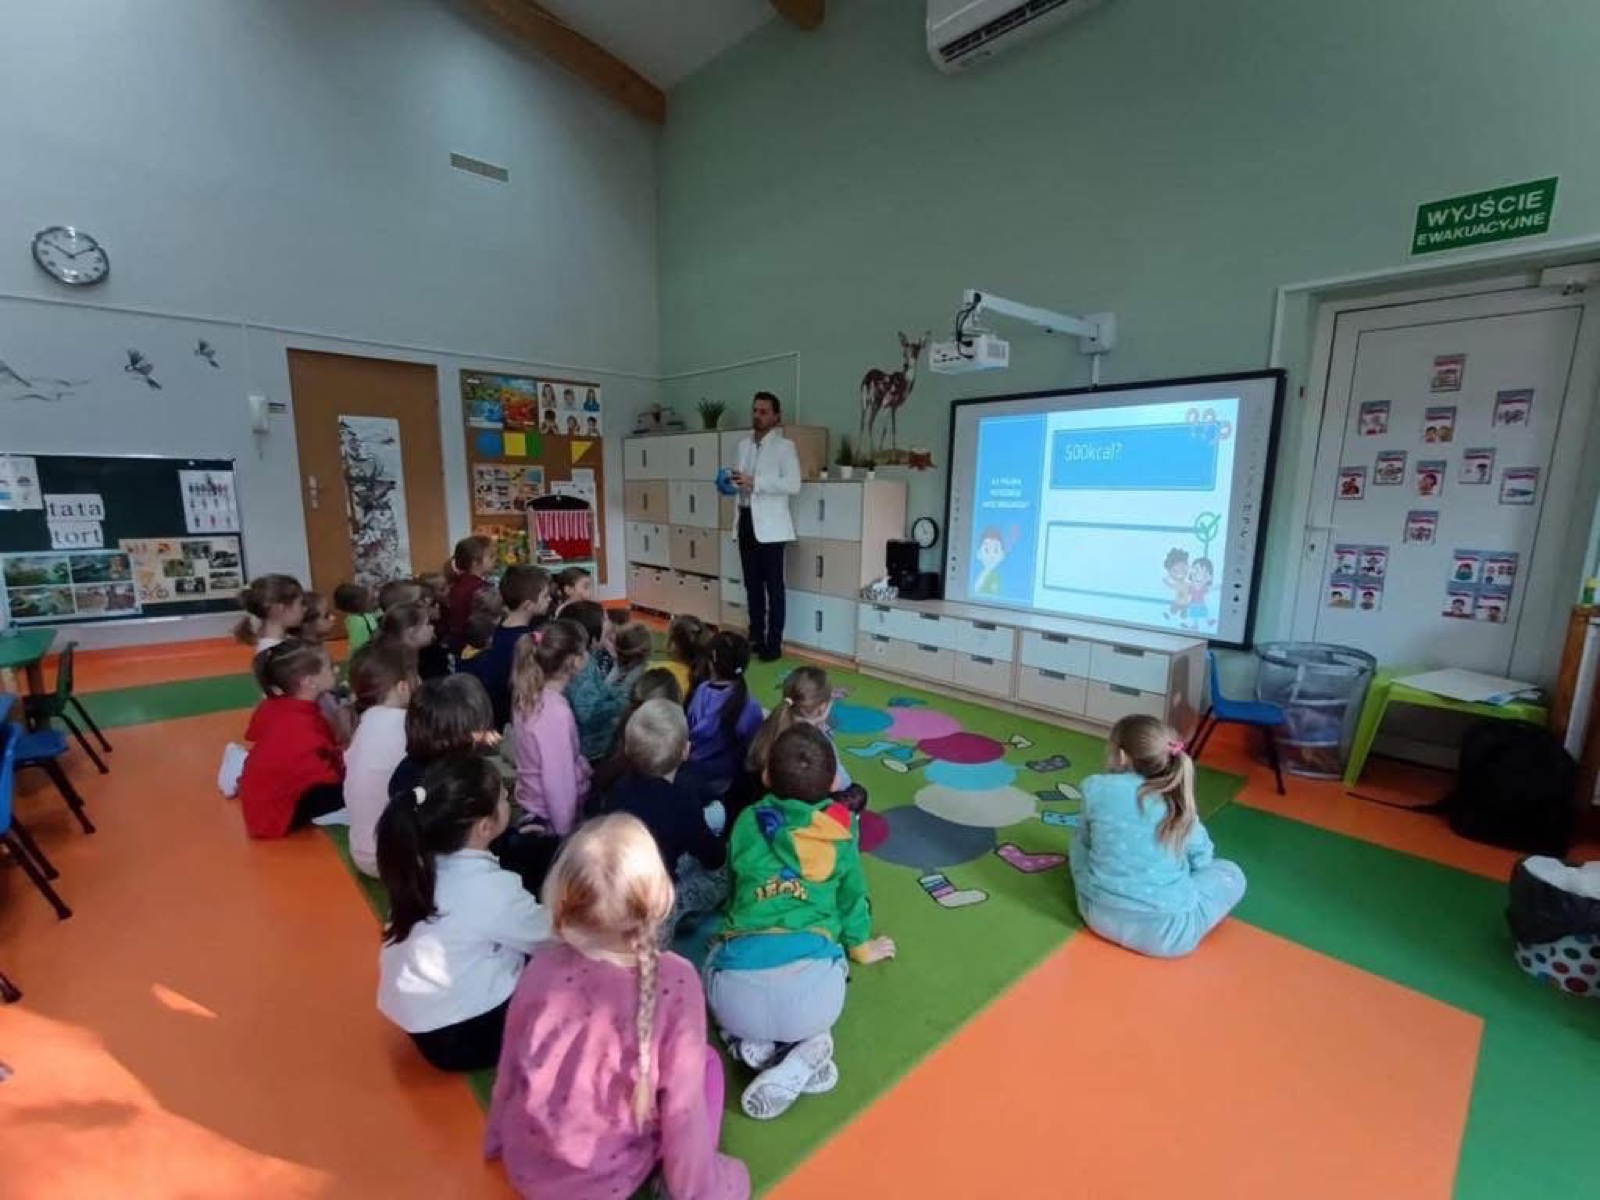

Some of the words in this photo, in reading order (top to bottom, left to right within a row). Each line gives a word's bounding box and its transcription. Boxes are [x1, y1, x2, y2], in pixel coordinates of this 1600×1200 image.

[1427, 189, 1545, 228] WYJŚCIE
[1416, 212, 1546, 246] EWAKUACYJNE
[1064, 442, 1123, 462] 500kcal?
[49, 502, 101, 517] tata
[54, 529, 101, 544] tort
